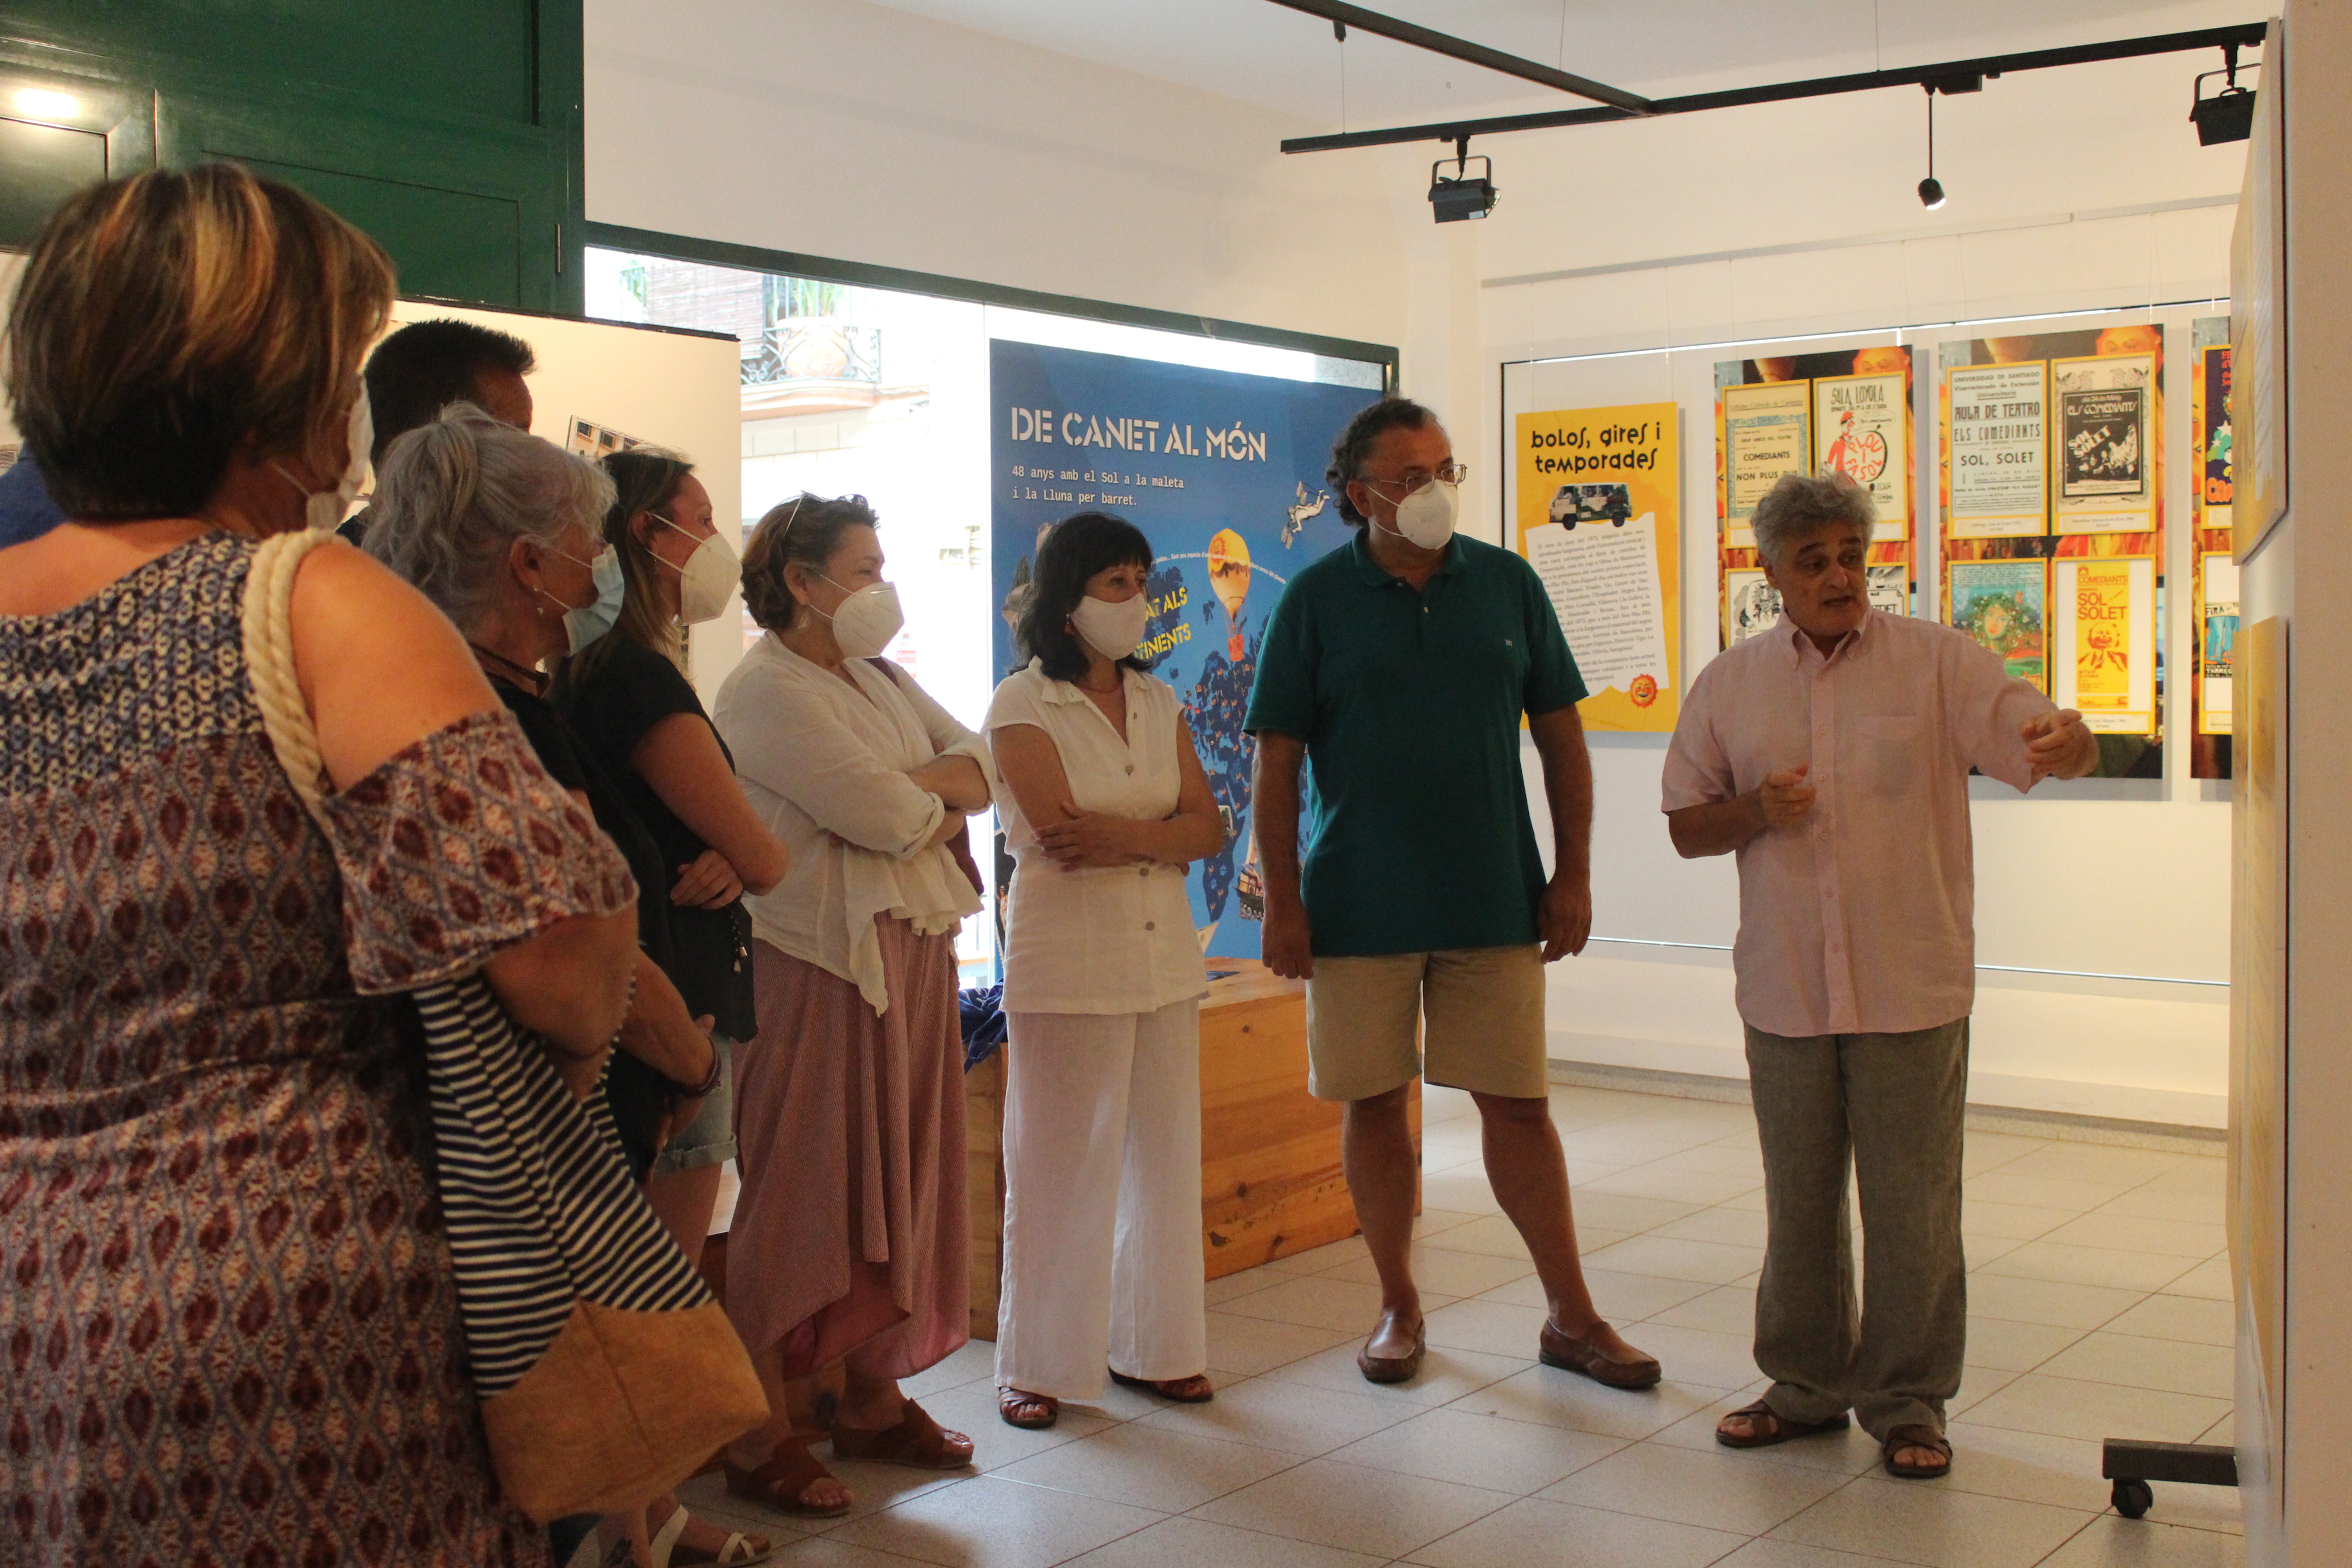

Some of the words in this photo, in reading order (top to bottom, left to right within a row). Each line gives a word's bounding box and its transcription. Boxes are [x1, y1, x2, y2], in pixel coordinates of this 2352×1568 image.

[1955, 406, 1980, 421] AULA
[1984, 404, 1997, 418] DE
[2002, 402, 2040, 417] TEATRO
[1011, 407, 1052, 443] DE
[1061, 412, 1160, 452] CANET
[1164, 422, 1199, 456] AL
[1206, 421, 1266, 462] MÓN
[1531, 427, 1590, 449] bolos,
[1600, 423, 1648, 447] gires
[1656, 422, 1661, 440] i
[1954, 428, 1970, 442] ELS
[1979, 424, 2040, 441] COMEDIANTS
[1848, 434, 1883, 454] PLOU
[1535, 448, 1657, 474] temporades
[1744, 451, 1790, 461] COMEDIANTS
[1961, 455, 1989, 466] SOL,
[1997, 451, 2034, 465] SOLET
[1012, 465, 1024, 477] 48
[1031, 466, 1054, 481] anys
[1060, 468, 1079, 481] amb
[1084, 469, 1096, 482] el
[1102, 471, 1118, 484] Sol
[1124, 475, 1131, 485] a
[1136, 474, 1147, 486] la
[1152, 475, 1184, 489] maleta
[1736, 473, 1755, 481] NON
[1760, 471, 1778, 479] PLUS
[1013, 487, 1019, 499] i
[1025, 486, 1038, 500] la
[1044, 488, 1073, 502] Lluna
[1078, 492, 1095, 505] per
[1102, 491, 1137, 505] barret.
[1163, 587, 1188, 614] ALS
[2078, 593, 2107, 606] SOL
[2078, 606, 2127, 620] SOLET
